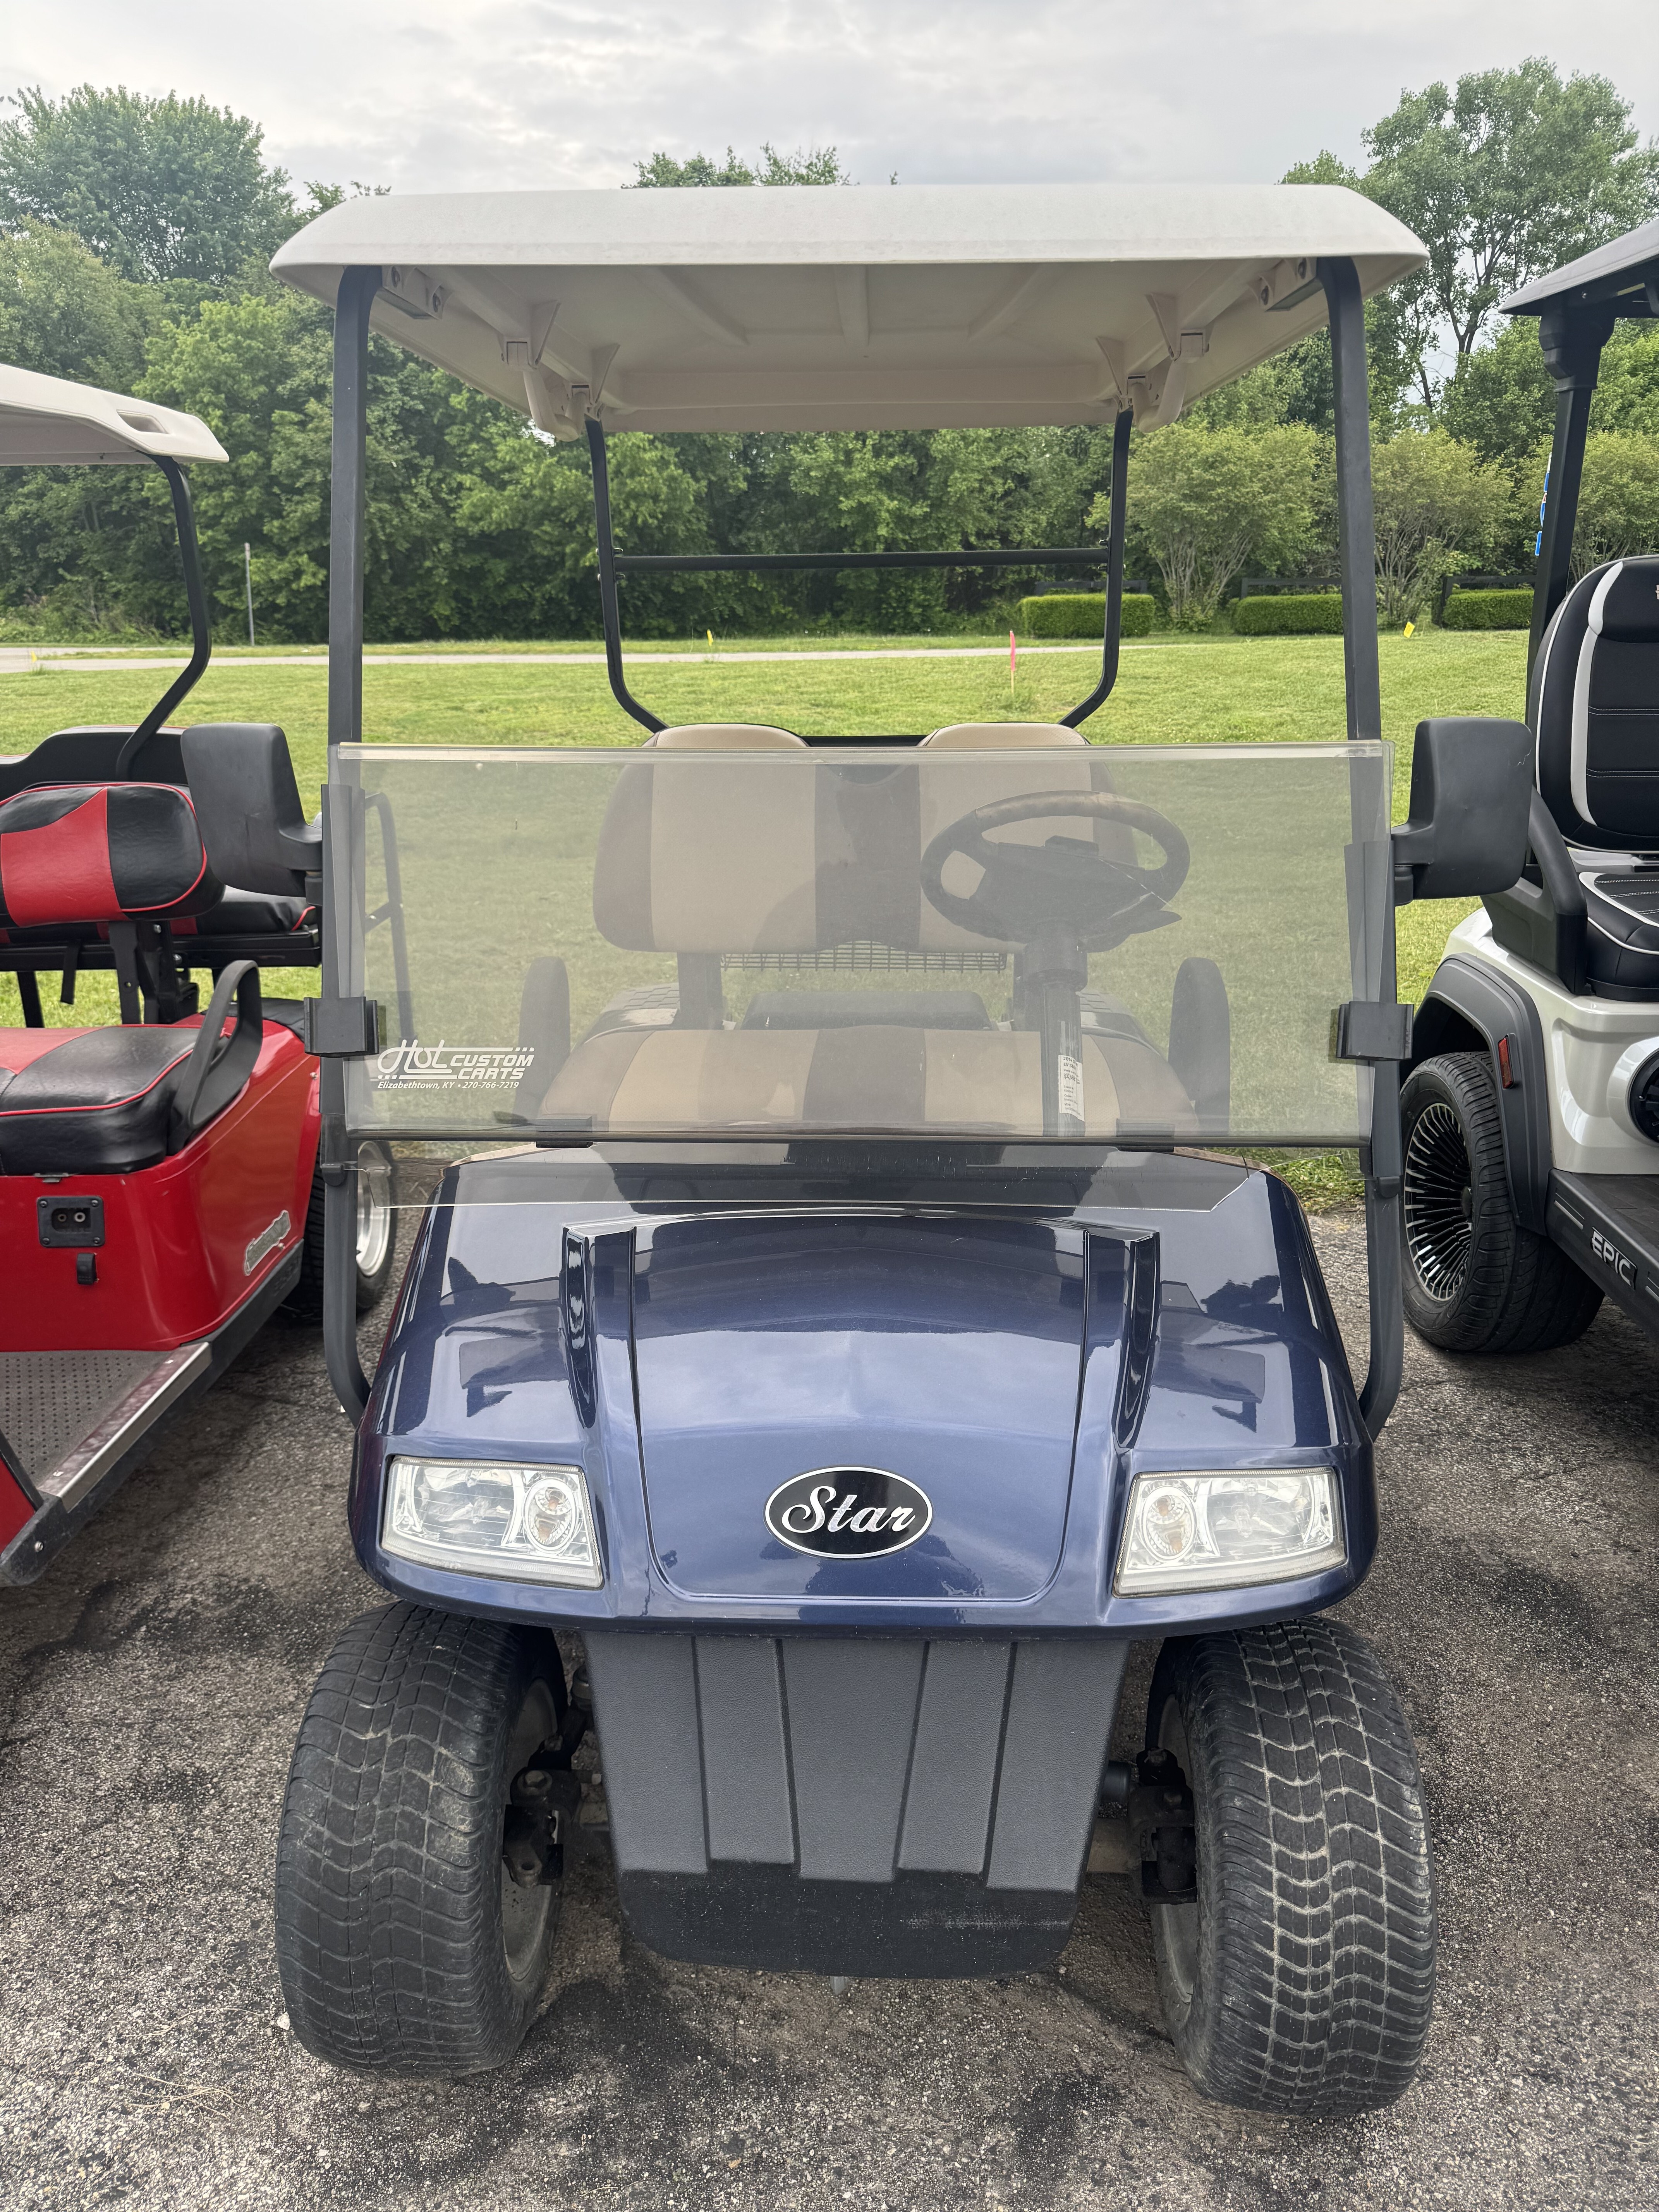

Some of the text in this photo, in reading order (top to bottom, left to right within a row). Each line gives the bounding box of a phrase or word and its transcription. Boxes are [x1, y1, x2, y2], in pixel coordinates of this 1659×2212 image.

[377, 1039, 535, 1073] Hot CUSTOM
[378, 1081, 440, 1089] Elizabethtown,
[458, 1068, 526, 1079] CARTS
[1592, 1231, 1632, 1286] EPIC
[781, 1486, 916, 1534] Star
